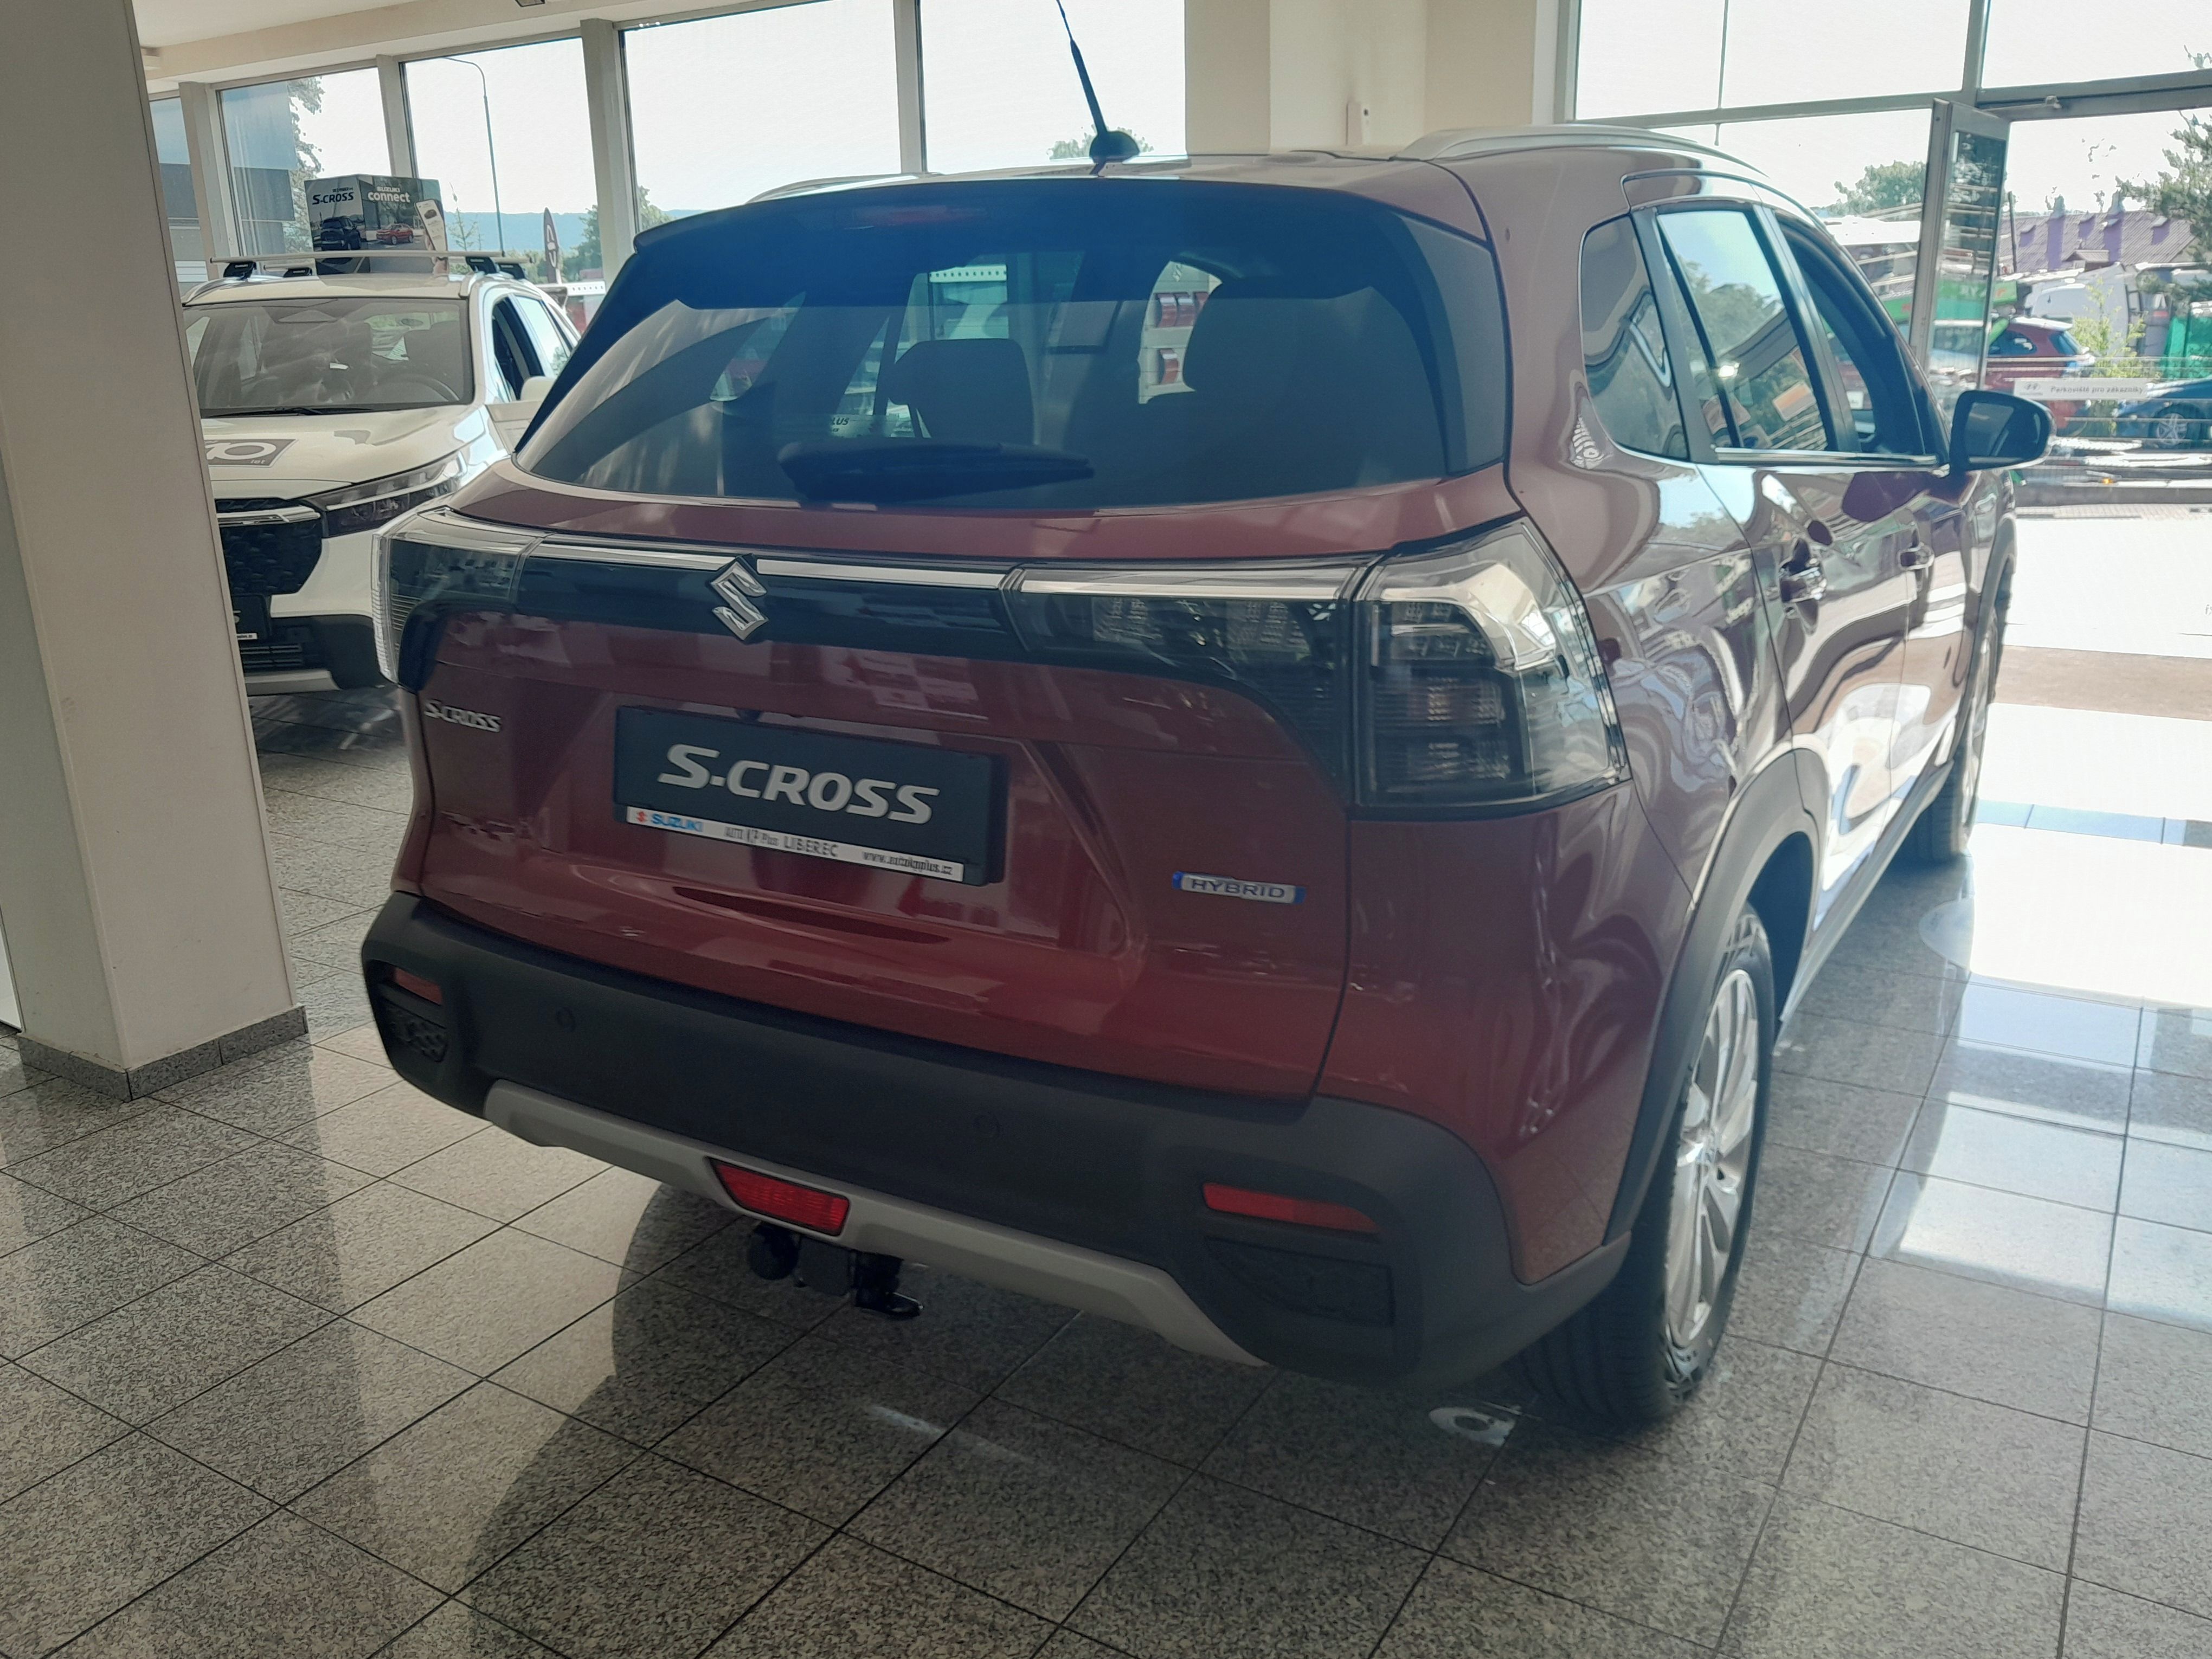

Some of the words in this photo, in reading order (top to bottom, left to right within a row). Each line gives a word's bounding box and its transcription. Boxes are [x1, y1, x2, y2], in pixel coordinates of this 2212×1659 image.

[312, 191, 354, 205] S-CROSS
[368, 192, 410, 203] connect
[832, 417, 850, 425] LUS
[658, 744, 940, 825] S-CROSS
[652, 813, 703, 832] SUZUKI
[784, 835, 838, 857] LIBEREC
[1192, 879, 1285, 898] HYBRID
